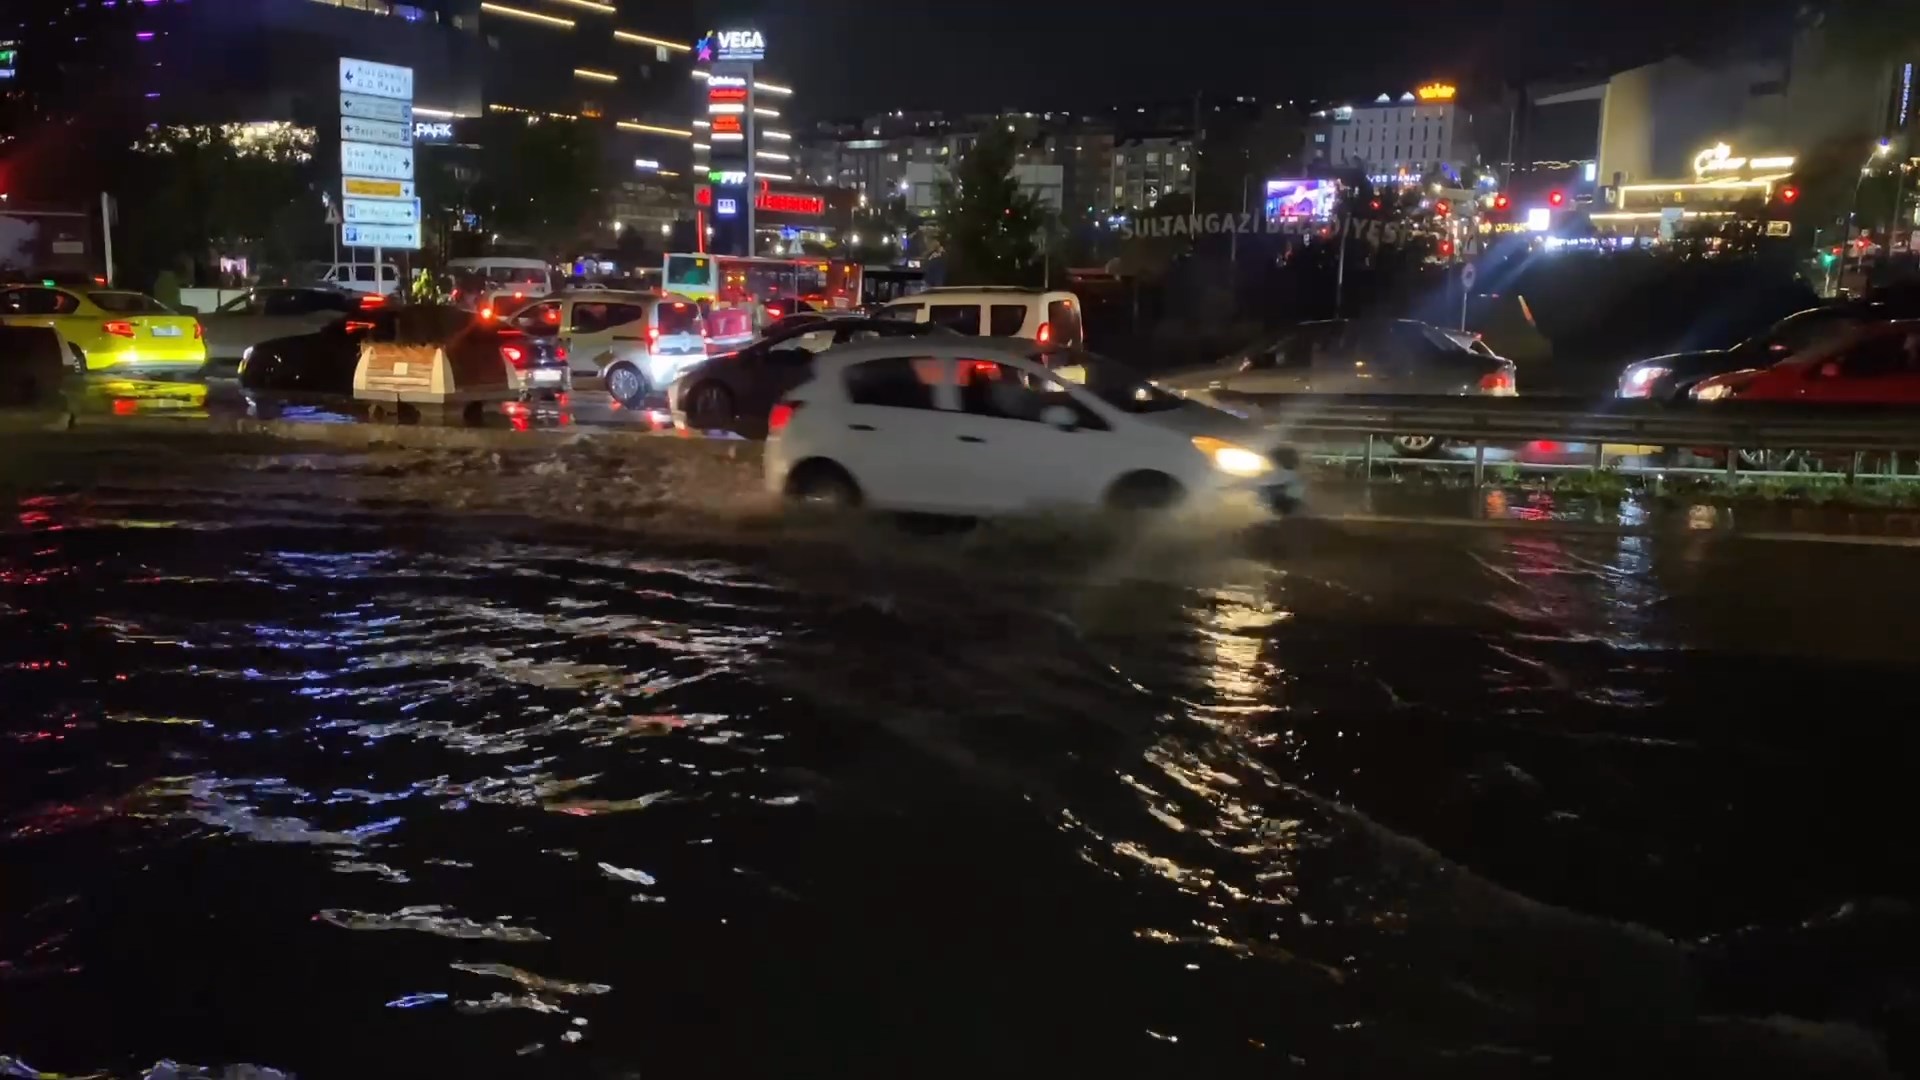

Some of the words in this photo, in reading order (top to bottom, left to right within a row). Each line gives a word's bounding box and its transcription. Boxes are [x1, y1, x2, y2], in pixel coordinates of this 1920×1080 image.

[718, 31, 764, 49] VEGA
[416, 123, 452, 138] PARK
[1120, 207, 1260, 240] SULTANGAZİ
[1266, 212, 1408, 246] BELDİYESİ
